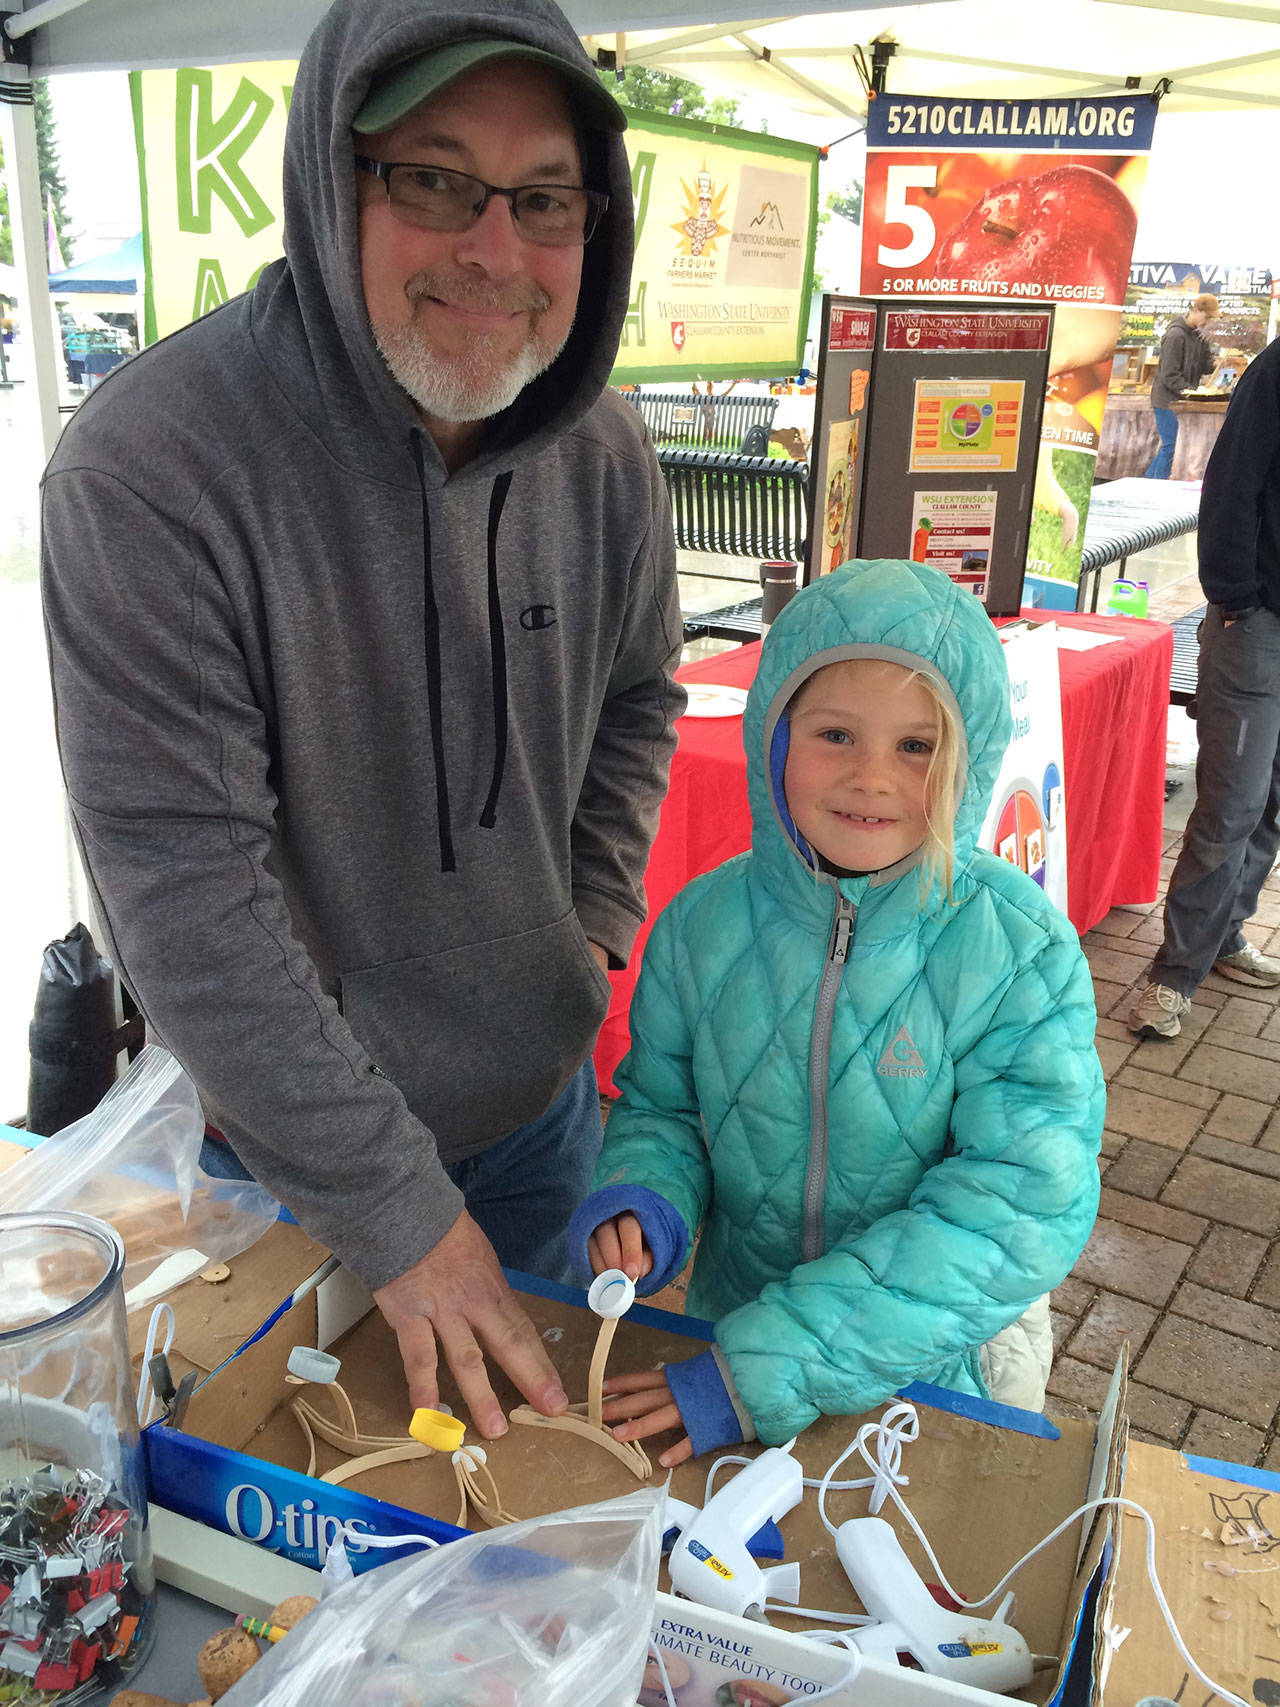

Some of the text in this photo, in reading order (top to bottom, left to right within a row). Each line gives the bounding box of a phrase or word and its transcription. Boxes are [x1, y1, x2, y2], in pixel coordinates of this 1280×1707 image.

[887, 105, 1136, 137] 5210CLALLAM.ORG
[877, 165, 937, 269] 5
[694, 271, 717, 280] MARKET
[883, 279, 1105, 300] 5 OR MORE FRUITS AND VEGGIES
[1065, 429, 1094, 446] TIME
[945, 496, 994, 504] EXTENSION
[876, 1065, 928, 1079] GERRY
[287, 1551, 315, 1560] Cotton
[661, 1619, 753, 1656] EXTRA VALUE
[709, 1650, 776, 1683] BEAUTY
